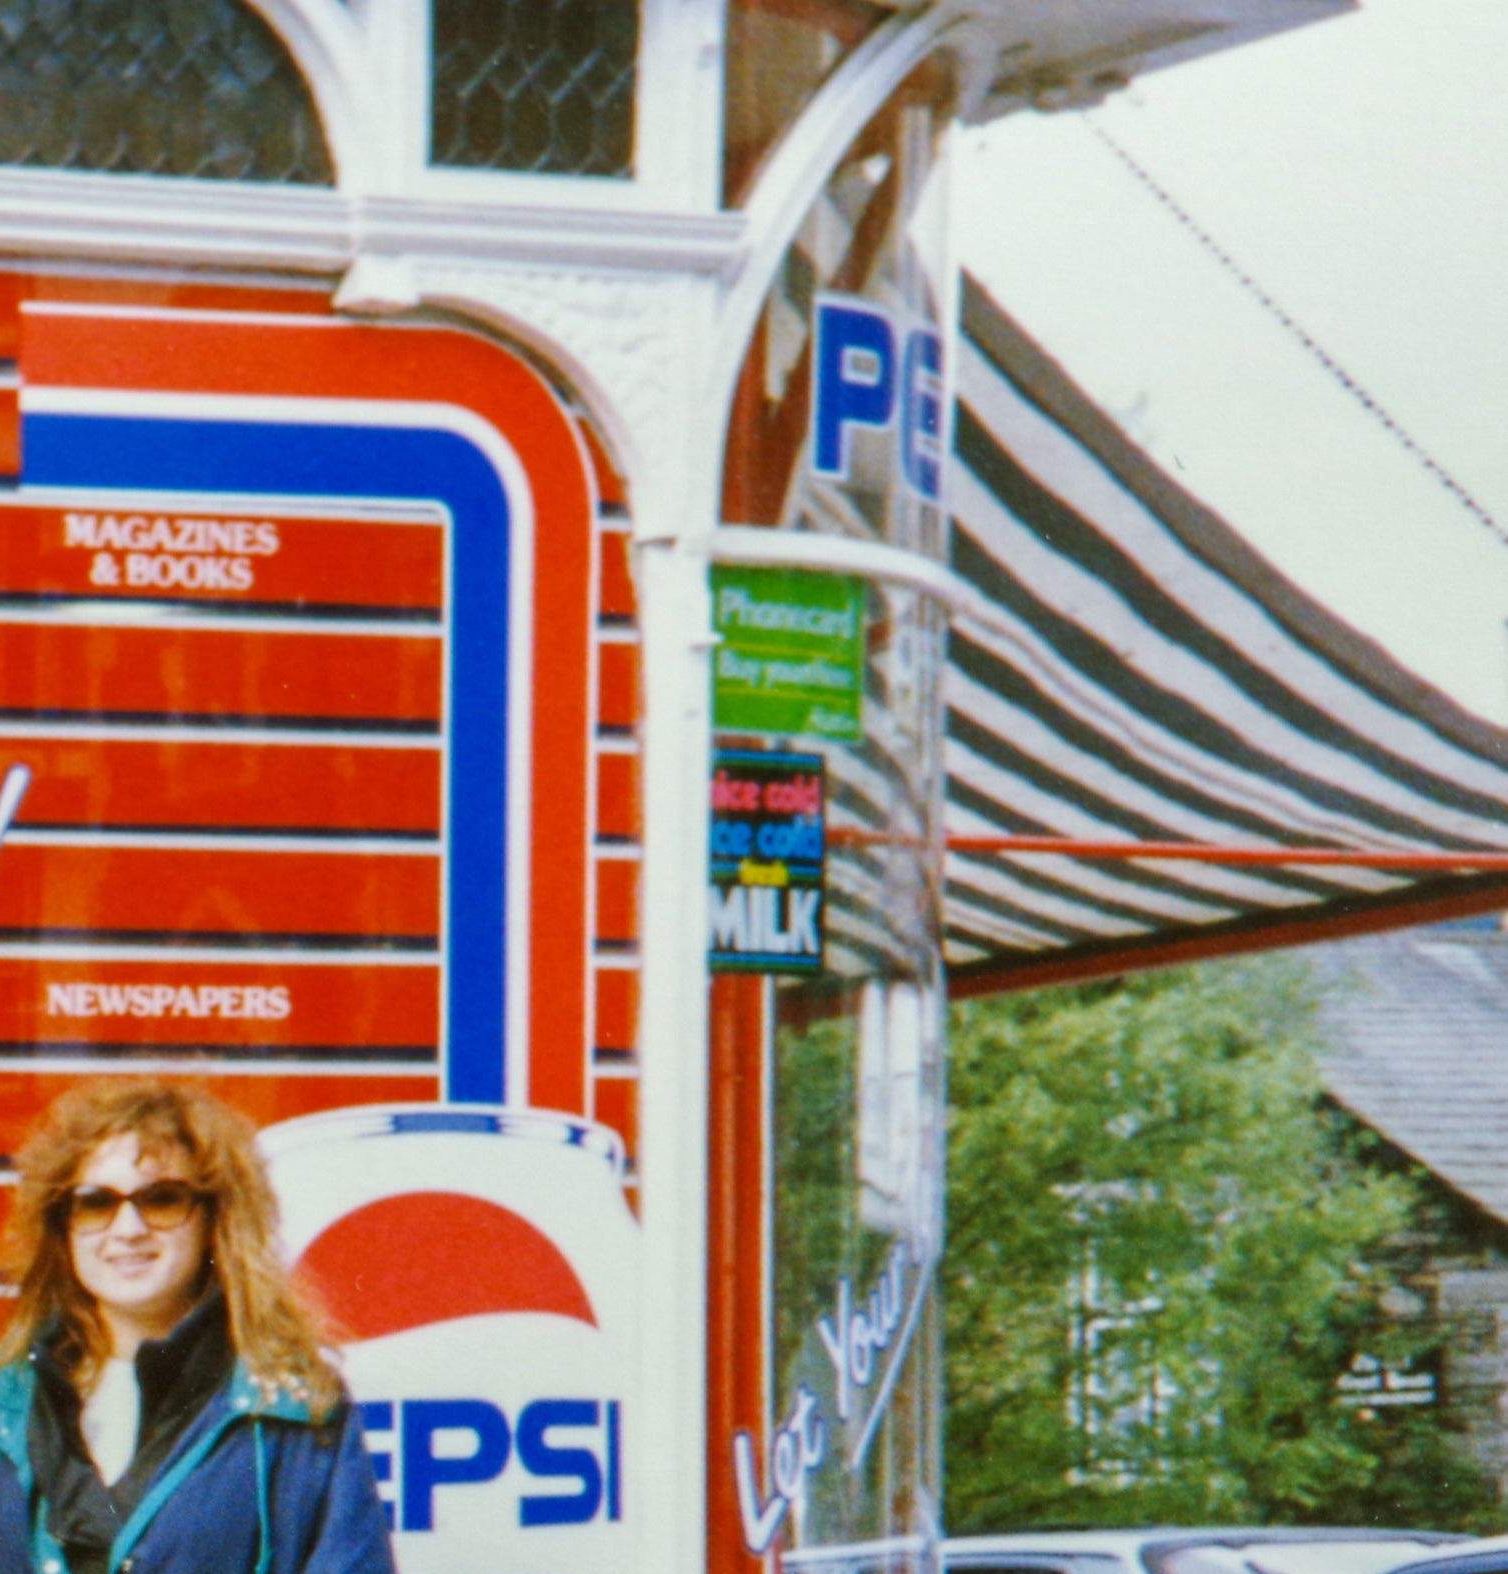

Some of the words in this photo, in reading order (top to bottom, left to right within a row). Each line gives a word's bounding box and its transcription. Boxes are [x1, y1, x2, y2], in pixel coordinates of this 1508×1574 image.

[813, 294, 943, 502] PE
[64, 512, 280, 555] MAGAZINES
[89, 551, 121, 586] &
[125, 552, 254, 590] BOOKS
[764, 774, 821, 814] cold
[710, 820, 753, 856] ce
[709, 885, 822, 953] MILK
[46, 982, 292, 1019] NEWSPAPERS
[816, 1240, 907, 1422] Your
